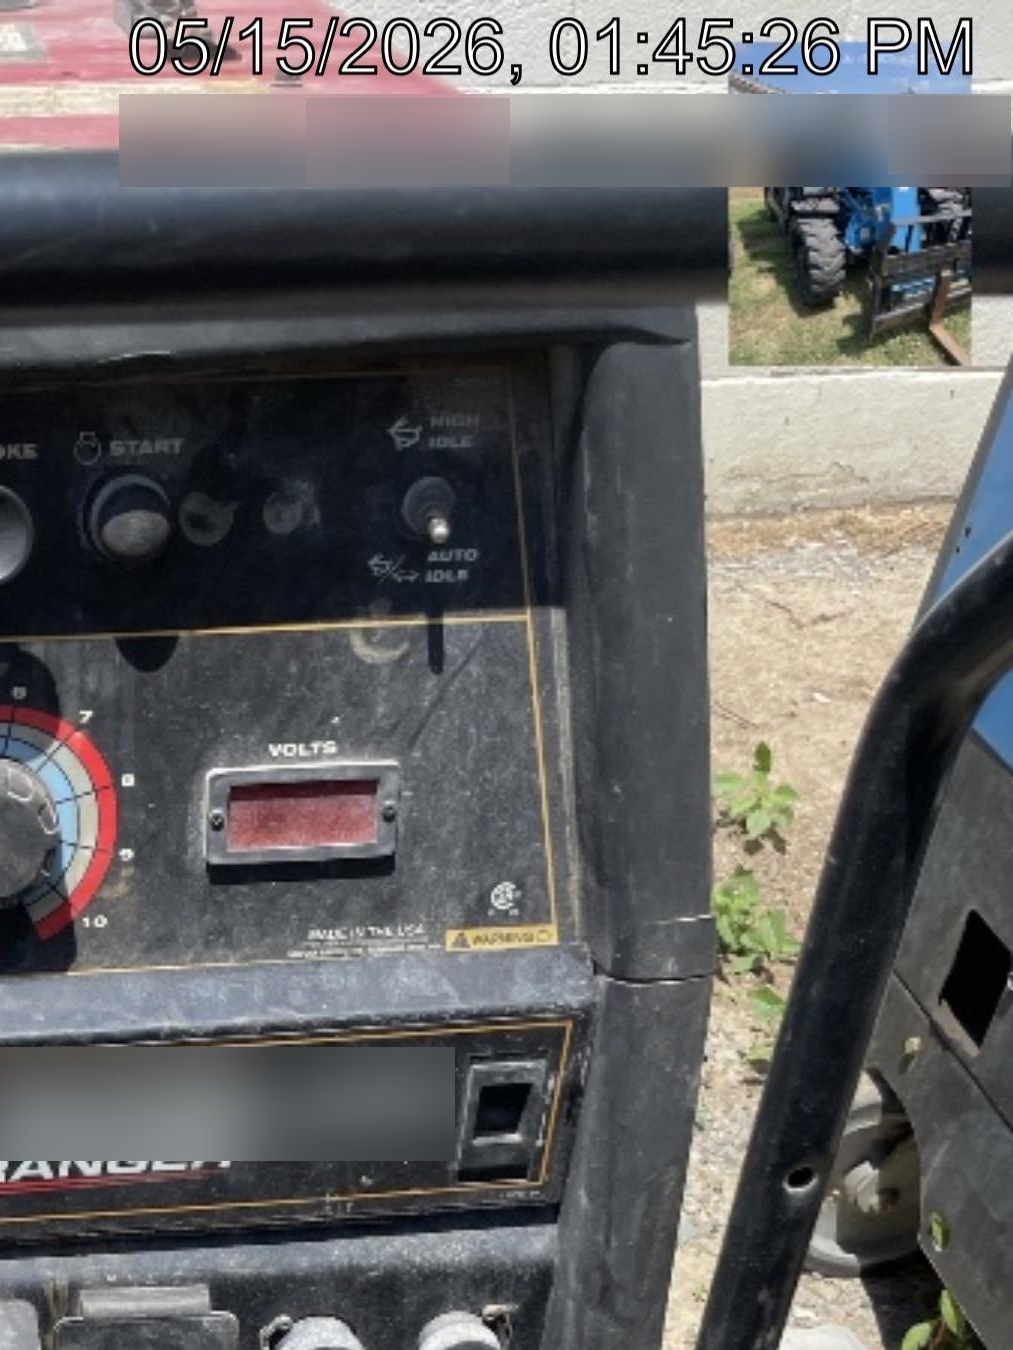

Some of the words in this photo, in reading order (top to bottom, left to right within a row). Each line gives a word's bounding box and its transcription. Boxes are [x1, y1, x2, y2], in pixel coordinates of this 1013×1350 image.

[431, 414, 479, 428] HIGH
[110, 437, 183, 457] START
[428, 434, 472, 448] IDLE
[428, 548, 478, 562] AUTO
[425, 568, 469, 583] IDLE
[79, 711, 93, 724] 7
[268, 741, 338, 757] VOLTS
[119, 849, 134, 861] 9
[83, 915, 108, 928] 10
